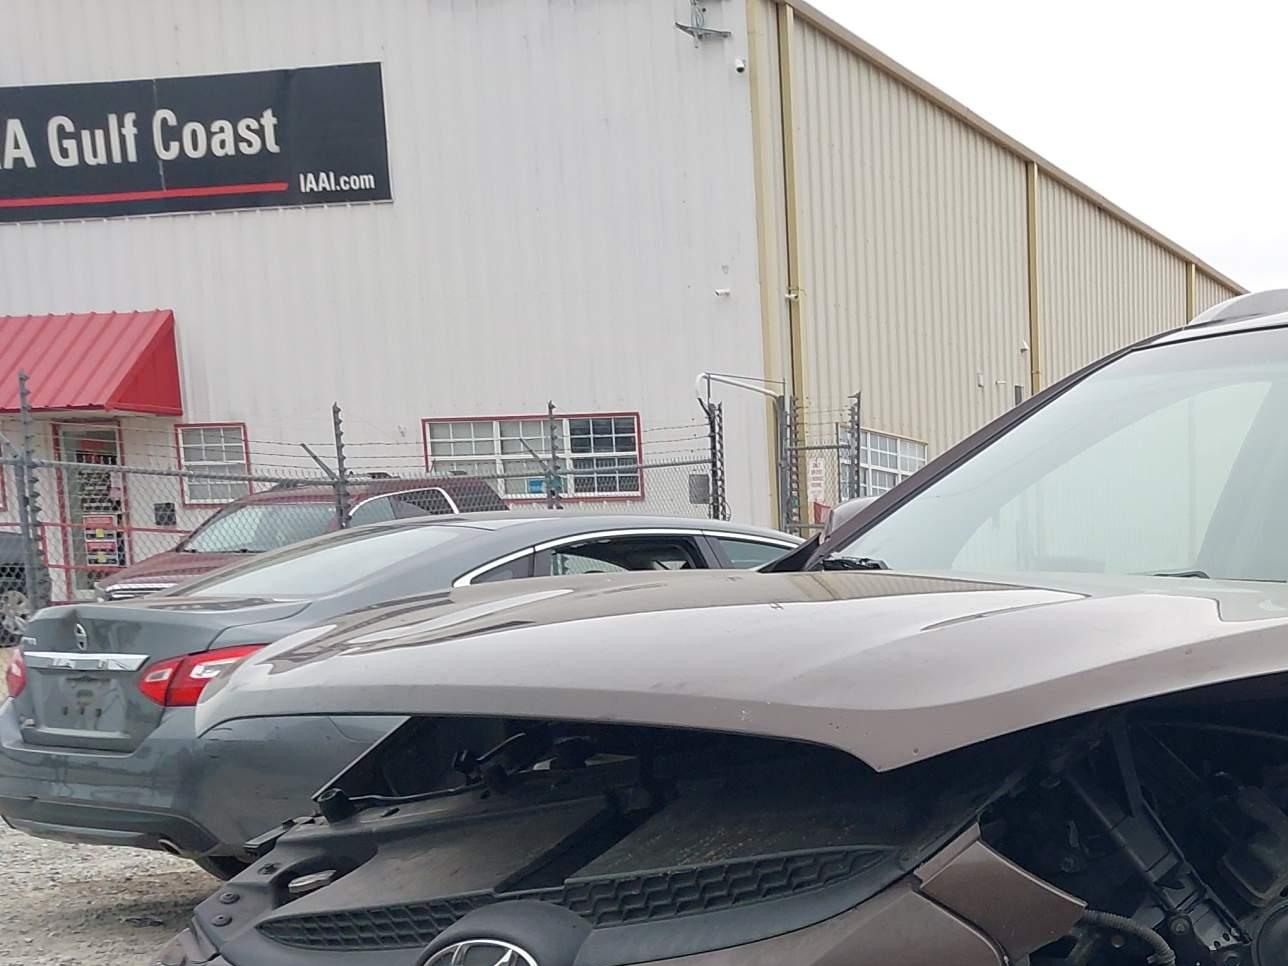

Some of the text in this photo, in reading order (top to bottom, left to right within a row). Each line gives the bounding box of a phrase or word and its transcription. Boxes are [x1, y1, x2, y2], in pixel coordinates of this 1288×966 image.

[0, 107, 281, 169] A Gulf Coast
[299, 171, 376, 193] IAAI.com
